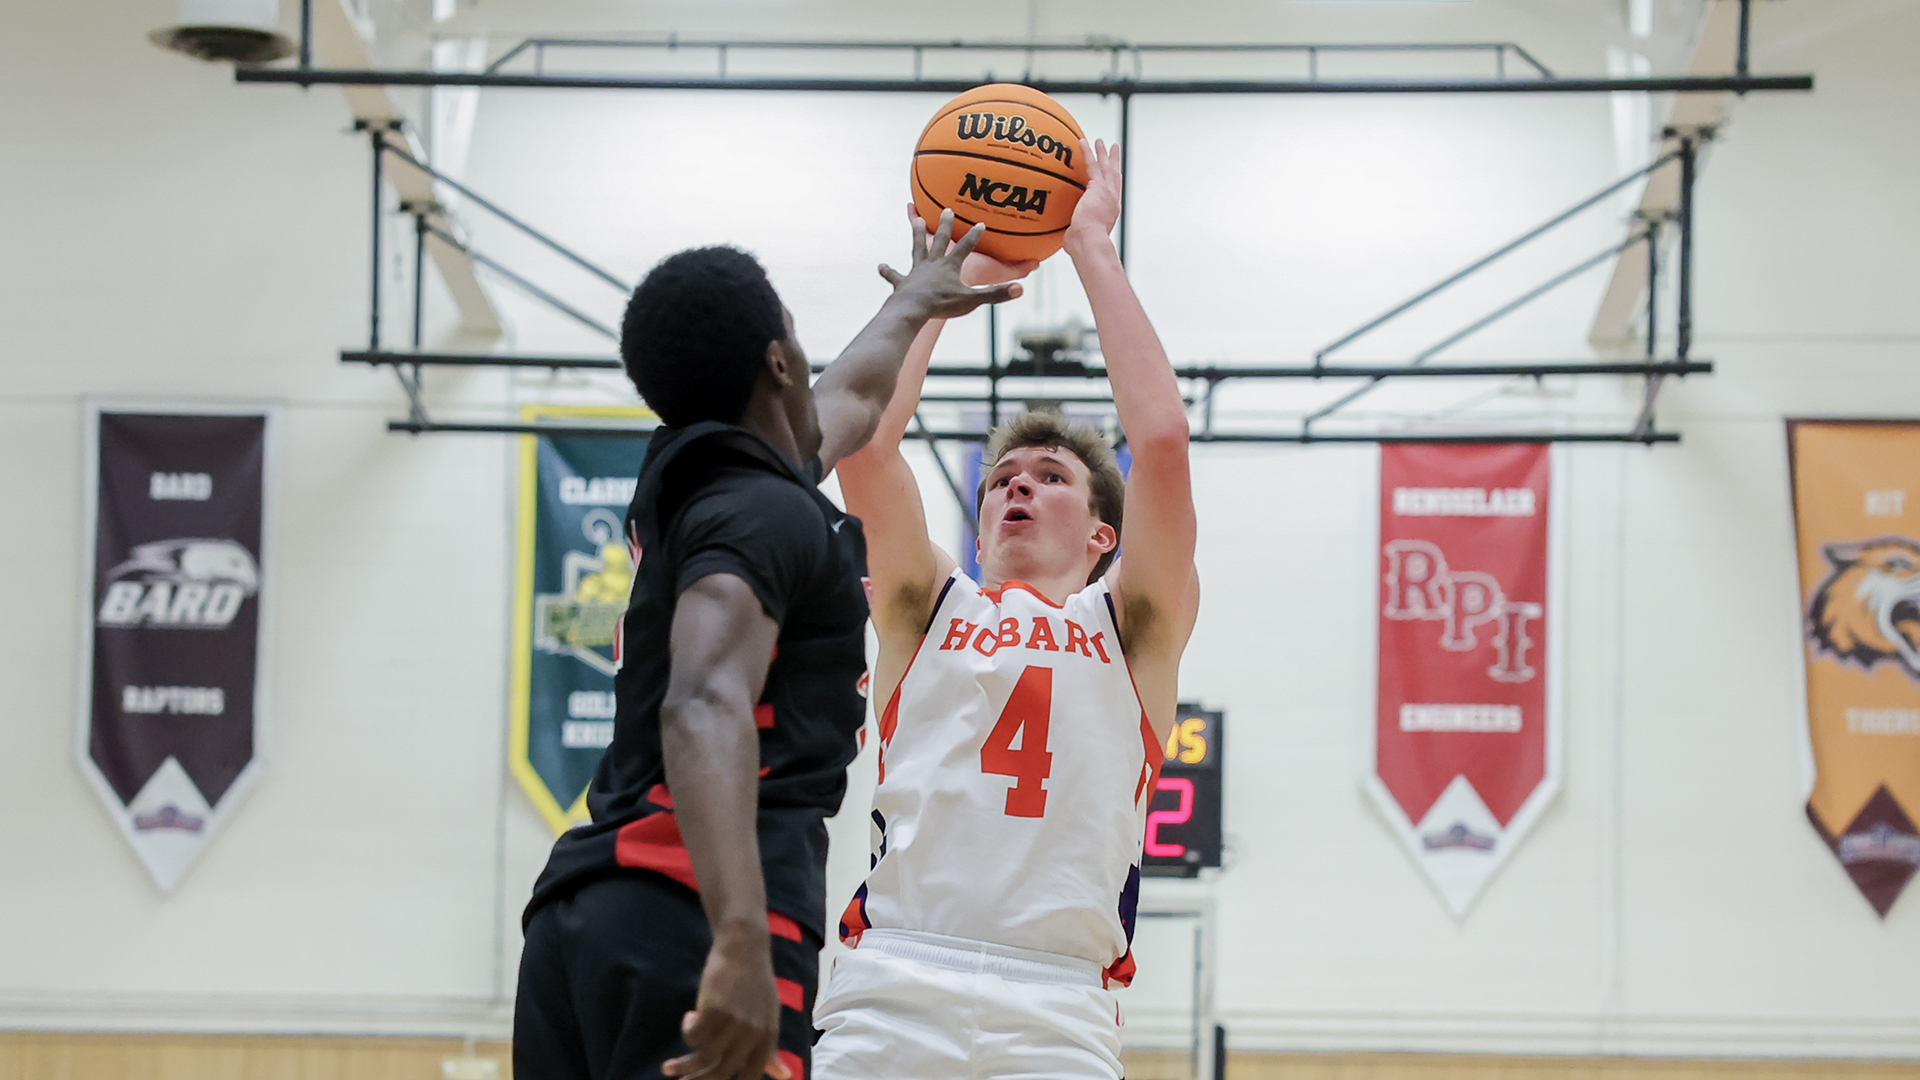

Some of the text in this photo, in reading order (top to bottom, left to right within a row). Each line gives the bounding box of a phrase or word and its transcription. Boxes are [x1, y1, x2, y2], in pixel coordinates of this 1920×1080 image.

[957, 112, 1074, 171] Wilson
[957, 172, 1049, 215] NCAA
[150, 471, 213, 501] BARD
[1392, 486, 1537, 517] RENSSELAER
[1864, 489, 1906, 517] RIT
[99, 580, 245, 625] BARD
[1384, 538, 1543, 684] RPI
[939, 616, 1111, 664] HOBART
[121, 684, 226, 716] RAPTORS
[1398, 702, 1524, 734] ENGINEERS
[980, 665, 1053, 819] 4
